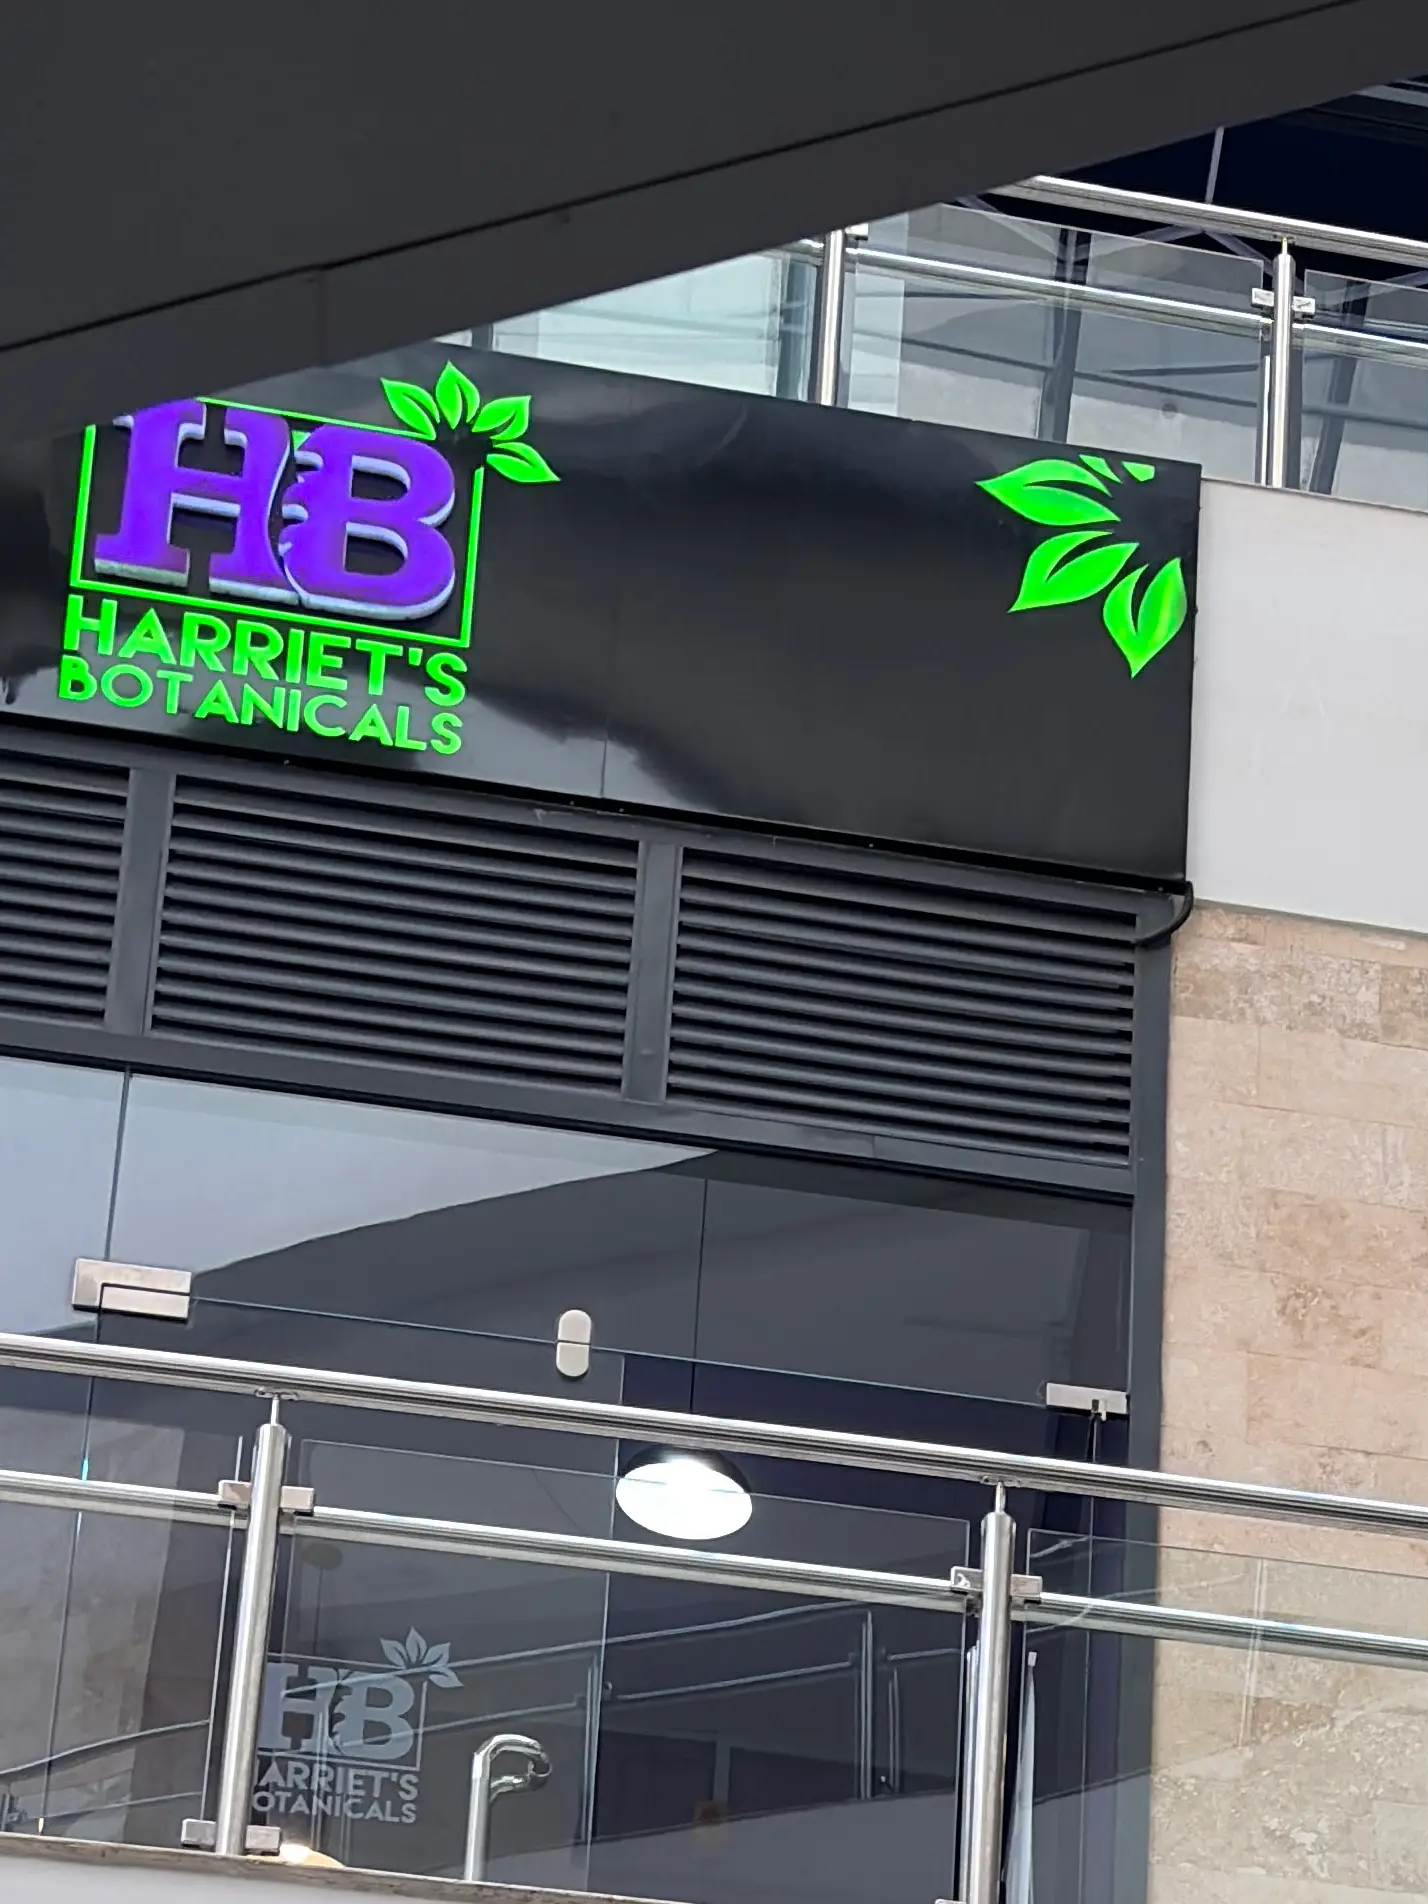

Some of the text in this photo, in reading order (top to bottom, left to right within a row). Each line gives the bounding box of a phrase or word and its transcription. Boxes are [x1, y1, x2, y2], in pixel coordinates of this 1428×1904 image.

[94, 400, 457, 621] HB
[63, 594, 468, 707] HARRIET'S
[58, 655, 465, 756] BOTANICALS
[257, 1662, 415, 1760] HB
[252, 1790, 417, 1824] OTANICALS
[256, 1760, 419, 1801] ARRIET'S
